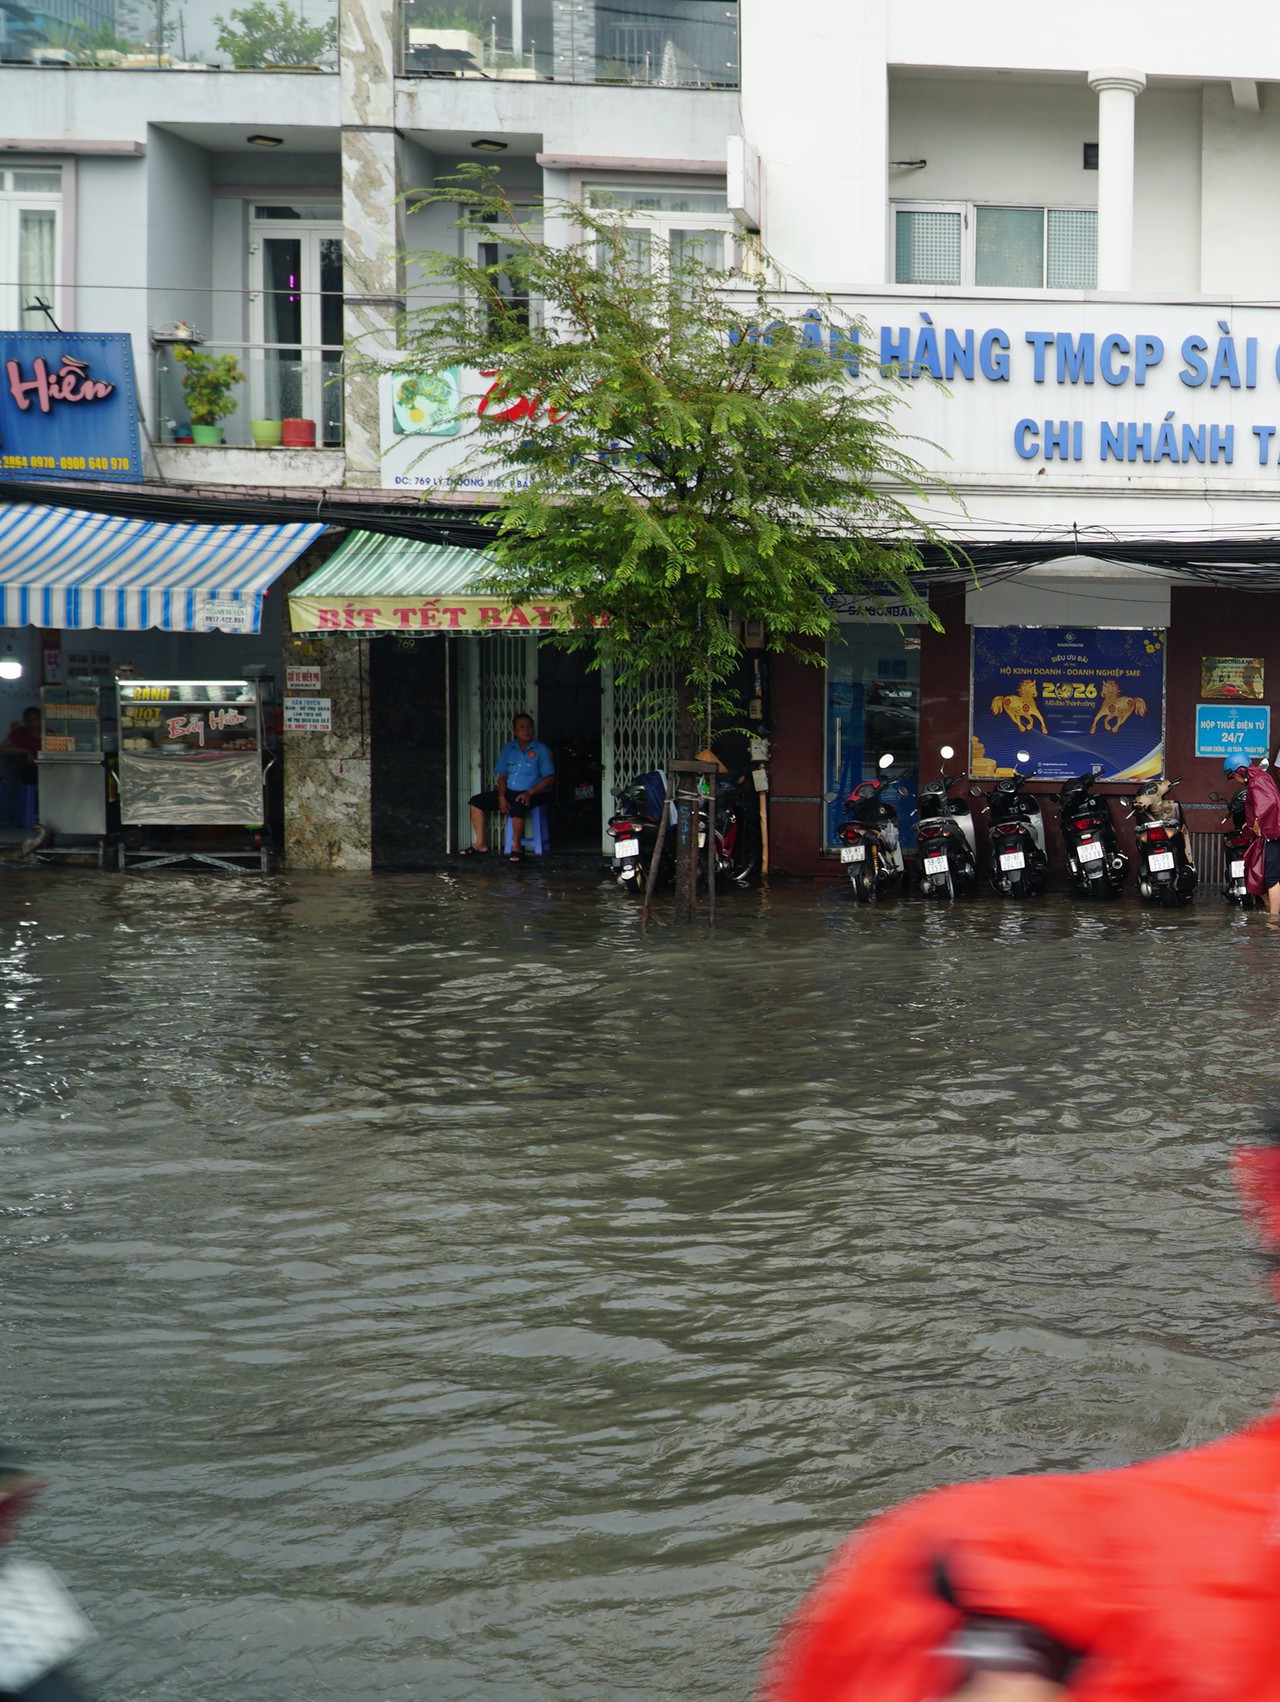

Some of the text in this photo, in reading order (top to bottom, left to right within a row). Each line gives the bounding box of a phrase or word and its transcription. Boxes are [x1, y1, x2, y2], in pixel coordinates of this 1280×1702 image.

[880, 312, 1011, 381] HÀNG
[1024, 330, 1164, 386] TMCP
[1178, 320, 1258, 389] SÀI
[6, 355, 116, 413] Hiền
[1013, 418, 1083, 461] CHI
[1099, 410, 1235, 465] NHÁNH
[110, 458, 130, 470] 970
[414, 477, 431, 486] 769
[316, 602, 383, 629] BÍT
[392, 598, 467, 629] TẾT
[397, 638, 416, 649] 769
[1050, 654, 1066, 663] SIÊU
[1000, 667, 1011, 675] HỘ
[1034, 668, 1062, 676] DOANH
[1096, 668, 1124, 677] NGHIỆP
[1200, 718, 1265, 732] NỘP THUẾ ĐIỆN TỬ
[1221, 732, 1245, 743] 24/7
